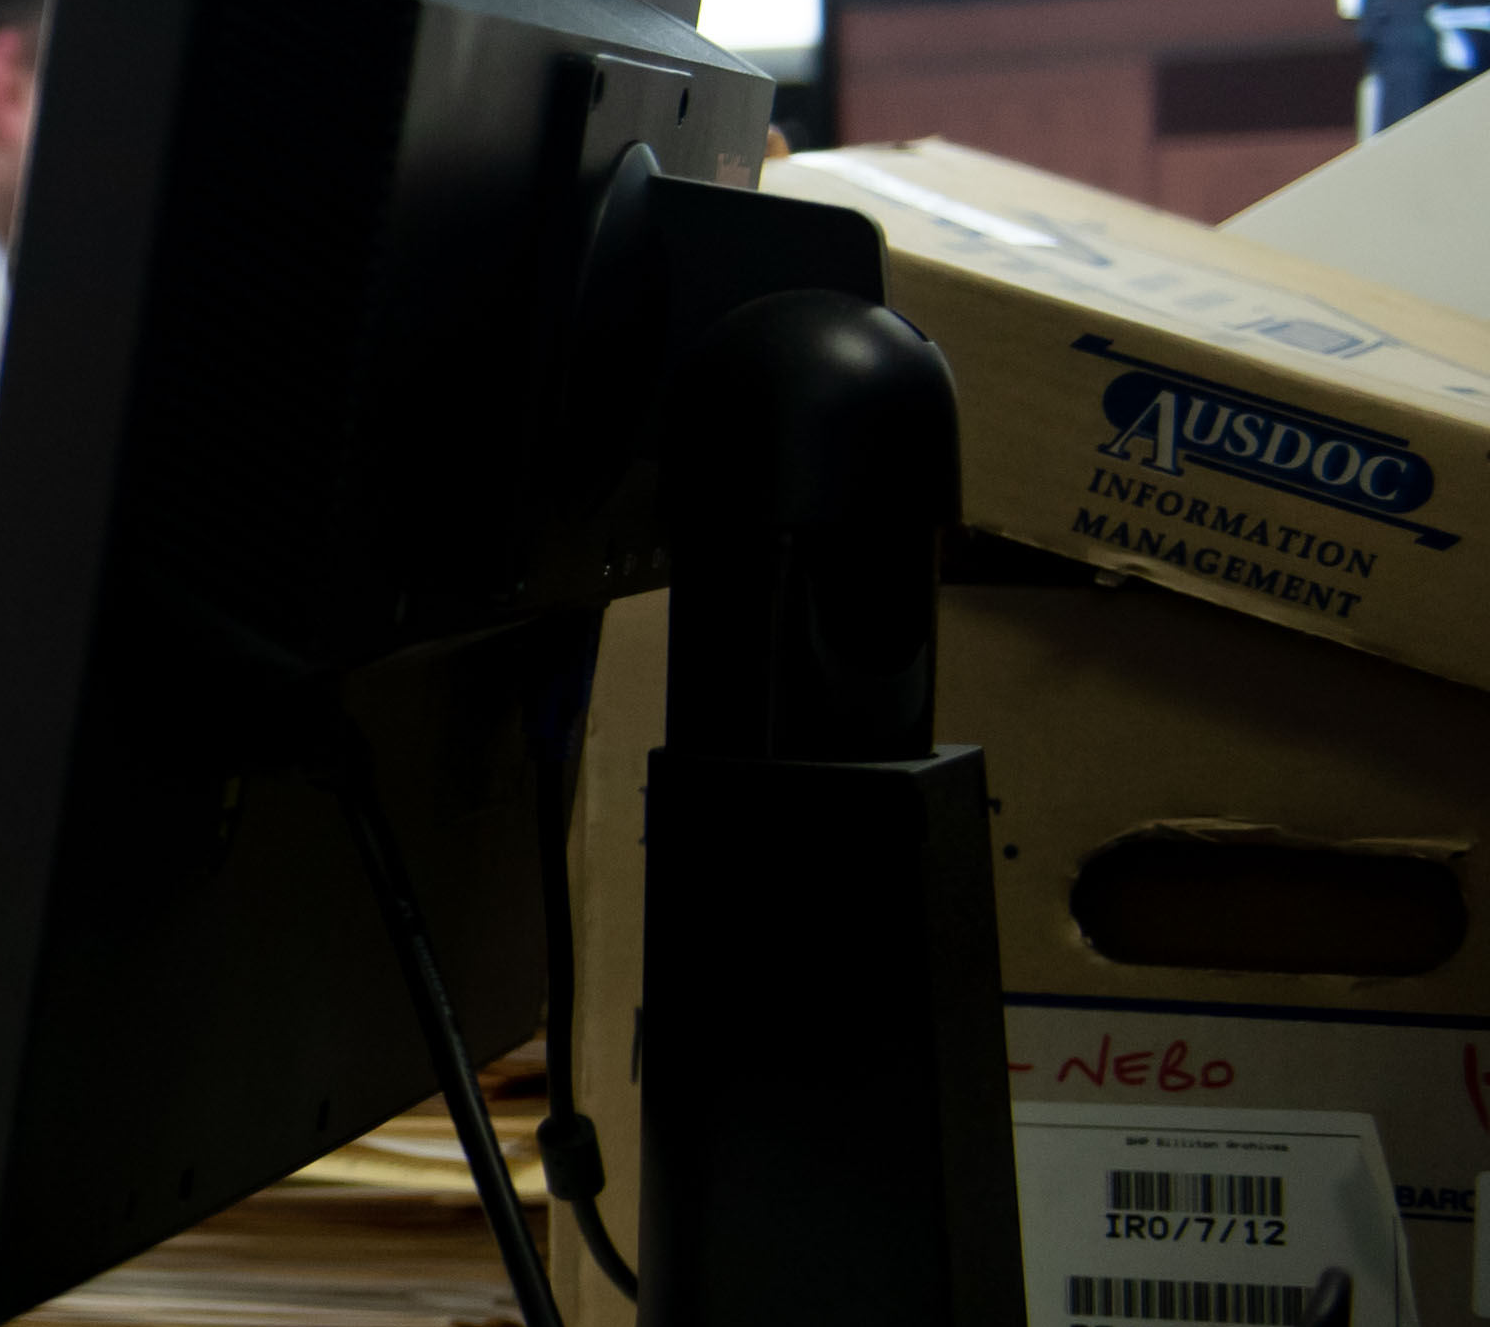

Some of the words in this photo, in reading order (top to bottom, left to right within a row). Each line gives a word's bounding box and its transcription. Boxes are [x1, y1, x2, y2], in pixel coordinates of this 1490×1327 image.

[1097, 389, 1413, 504] AUSDOC
[1070, 507, 1364, 621] MANAGEMENT
[1087, 467, 1380, 580] INFORMATION
[1057, 1035, 1236, 1092] NEBO
